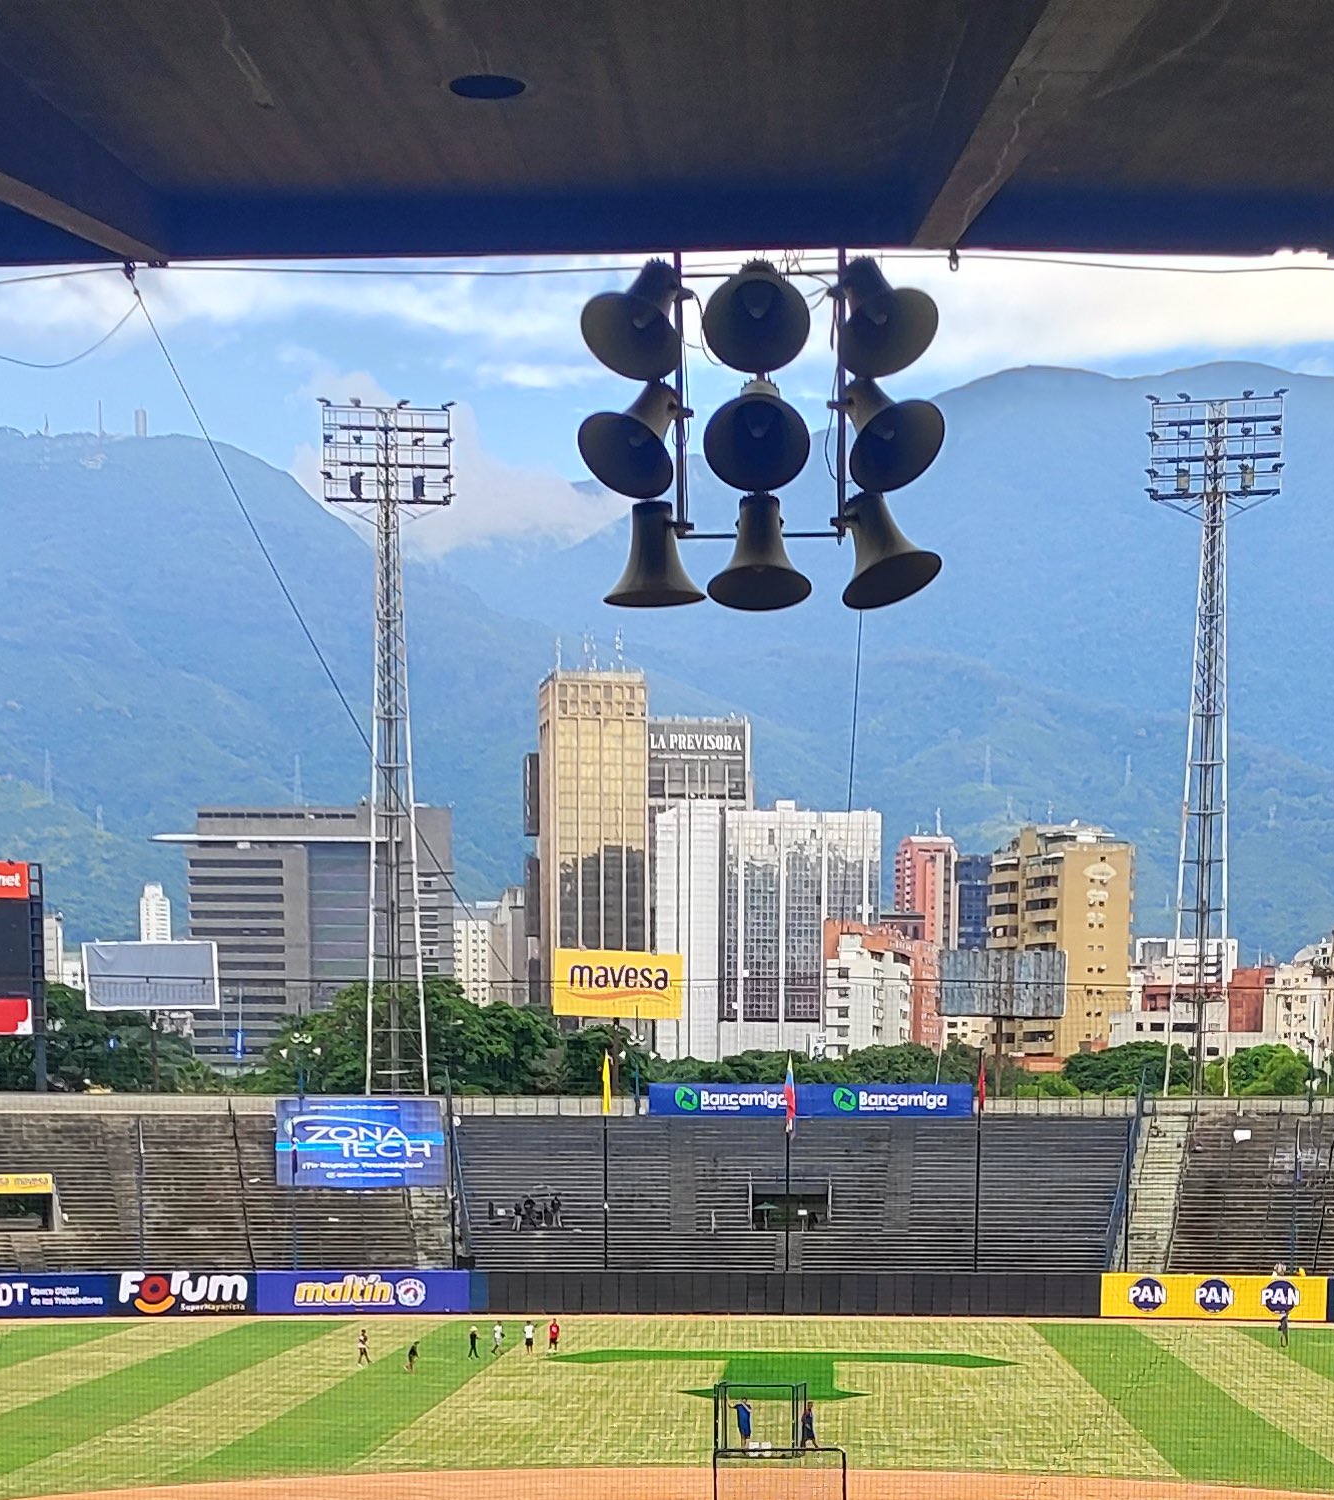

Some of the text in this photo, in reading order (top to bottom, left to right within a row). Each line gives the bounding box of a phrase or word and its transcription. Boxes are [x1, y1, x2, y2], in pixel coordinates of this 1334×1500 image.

[650, 733, 741, 751] LA PREVISORA
[570, 964, 668, 990] mavesa
[700, 1090, 788, 1107] Bancamiga
[859, 1090, 948, 1107] Bancamiga
[303, 1125, 407, 1143] ZONA
[342, 1141, 432, 1158] TECH
[119, 1271, 247, 1303] Forum
[295, 1274, 395, 1306] maltín
